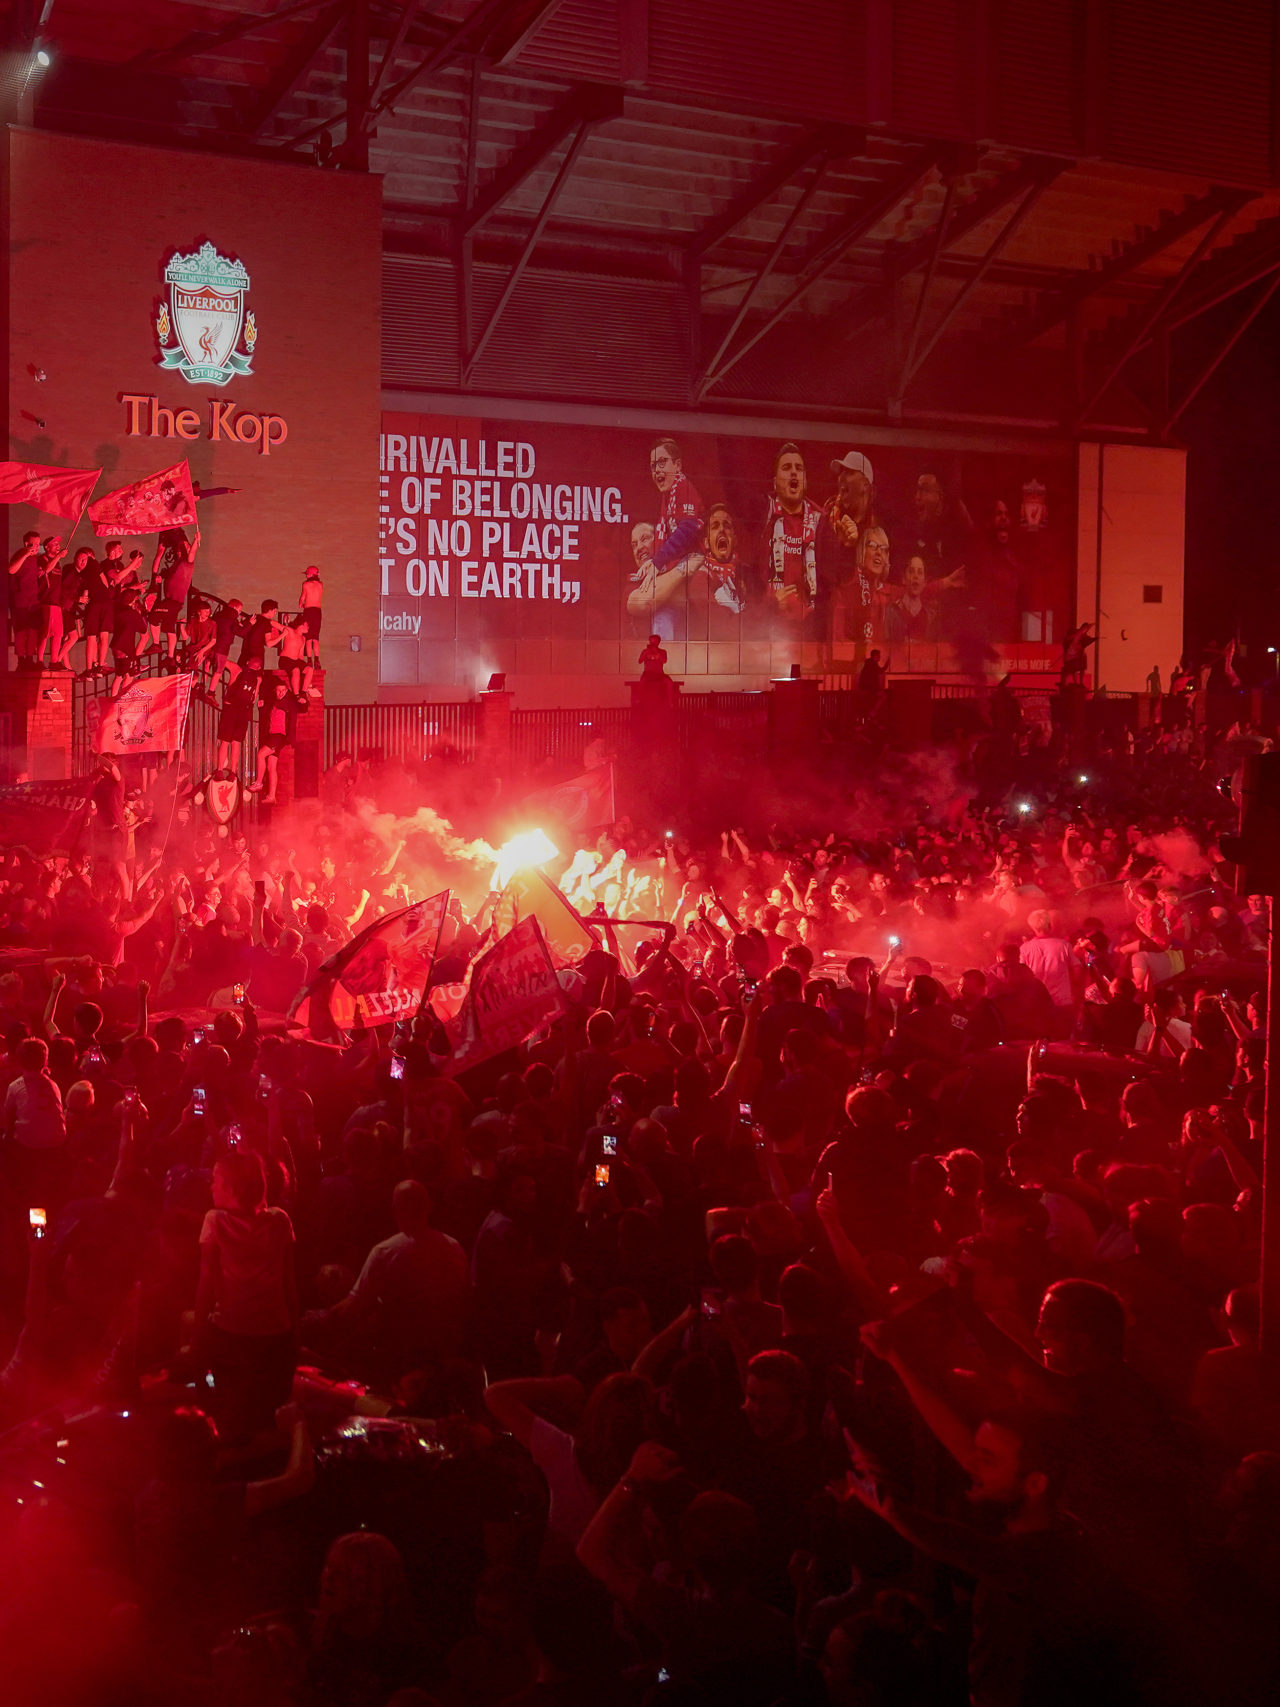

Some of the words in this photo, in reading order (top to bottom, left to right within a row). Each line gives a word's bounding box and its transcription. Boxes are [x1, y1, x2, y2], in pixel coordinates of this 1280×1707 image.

[178, 294, 238, 312] LIVERPOOL
[227, 279, 247, 288] ALONE
[122, 394, 200, 439] The
[208, 402, 288, 455] Kop
[400, 476, 442, 515] OF
[452, 479, 629, 524] BELONGING.
[427, 519, 471, 557] NO
[482, 522, 580, 560] PLACE
[406, 558, 450, 597] ON
